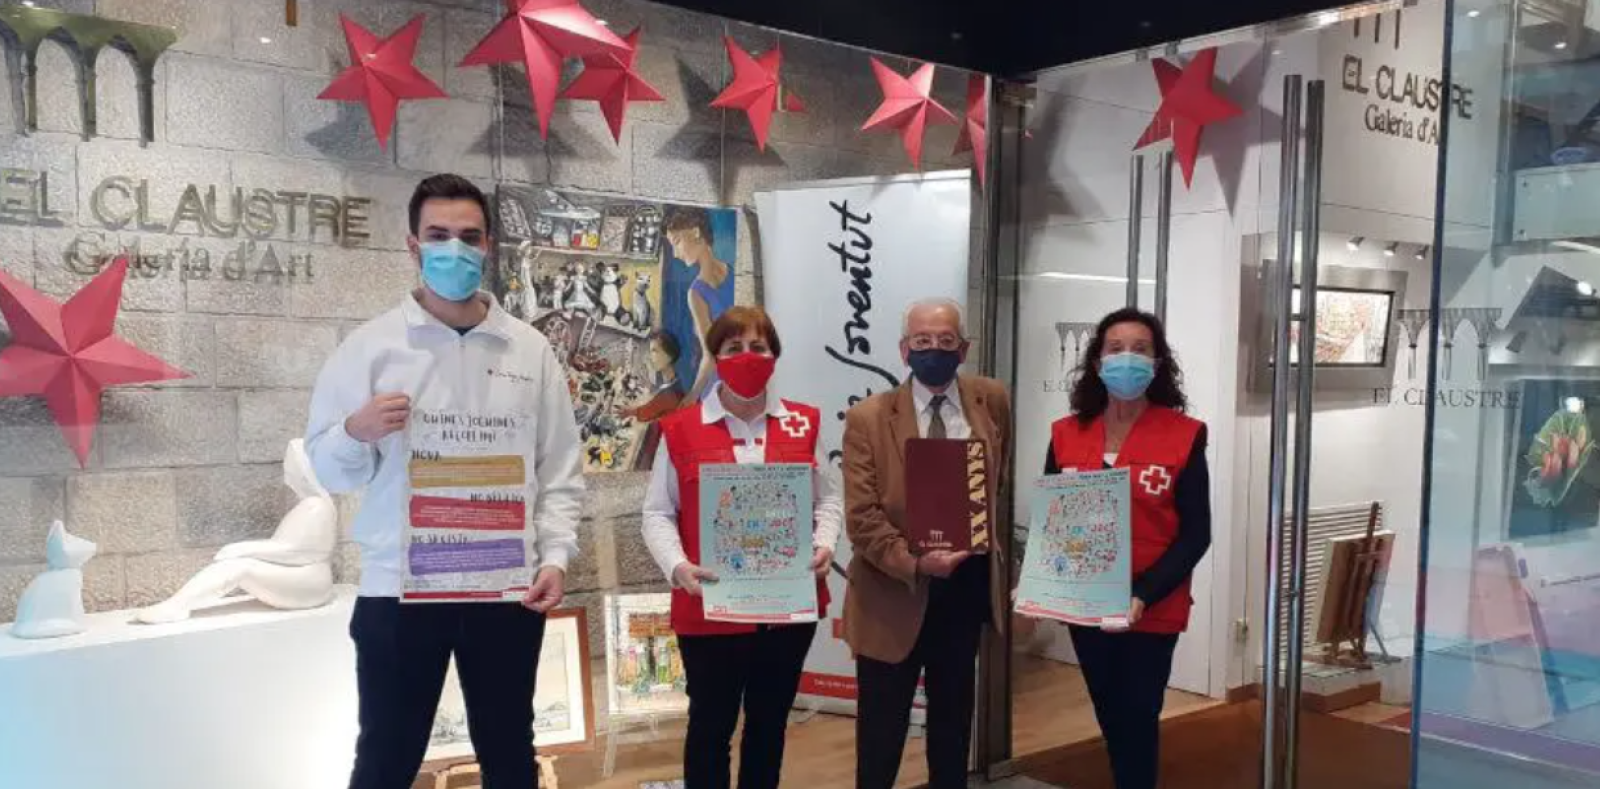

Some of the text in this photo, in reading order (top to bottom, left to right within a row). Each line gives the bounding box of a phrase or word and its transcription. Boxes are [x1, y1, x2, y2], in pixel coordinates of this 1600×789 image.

[1341, 54, 1474, 119] EL CLAUSRE
[1364, 103, 1414, 139] Galeria
[0, 167, 371, 247] EL CLAUSTRE
[222, 240, 315, 284] d'Art
[825, 200, 899, 387] Joventut
[966, 441, 989, 548] XX ANYS
